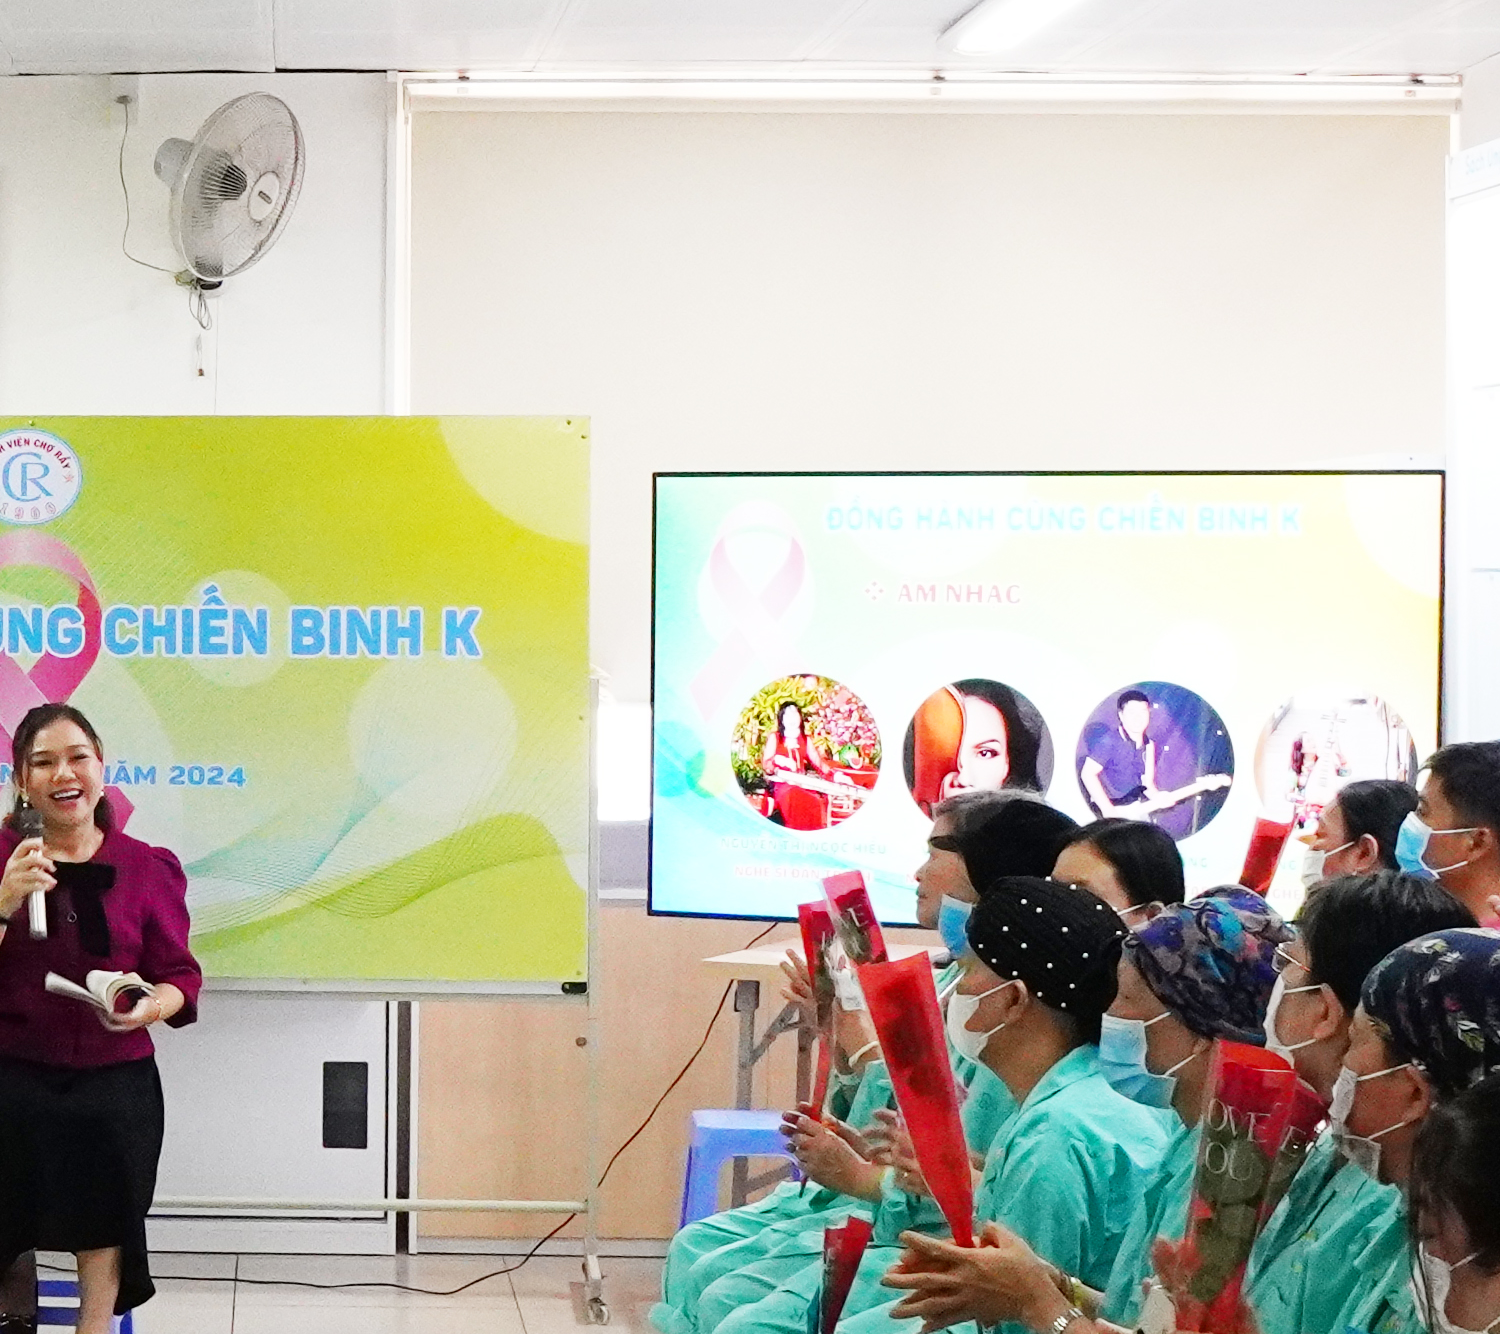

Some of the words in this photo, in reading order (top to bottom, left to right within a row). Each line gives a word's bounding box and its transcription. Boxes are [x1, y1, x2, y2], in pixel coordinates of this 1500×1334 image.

[916, 499, 996, 532] HÀNH
[1007, 499, 1087, 532] CÙNG
[1198, 506, 1270, 532] BINH
[1281, 506, 1300, 532] K
[103, 583, 270, 658] CHIẾN
[289, 606, 423, 657] BINH
[443, 606, 482, 658] K
[168, 765, 247, 788] 2024
[1208, 1097, 1272, 1143] OVE
[1205, 1141, 1253, 1182] OU
